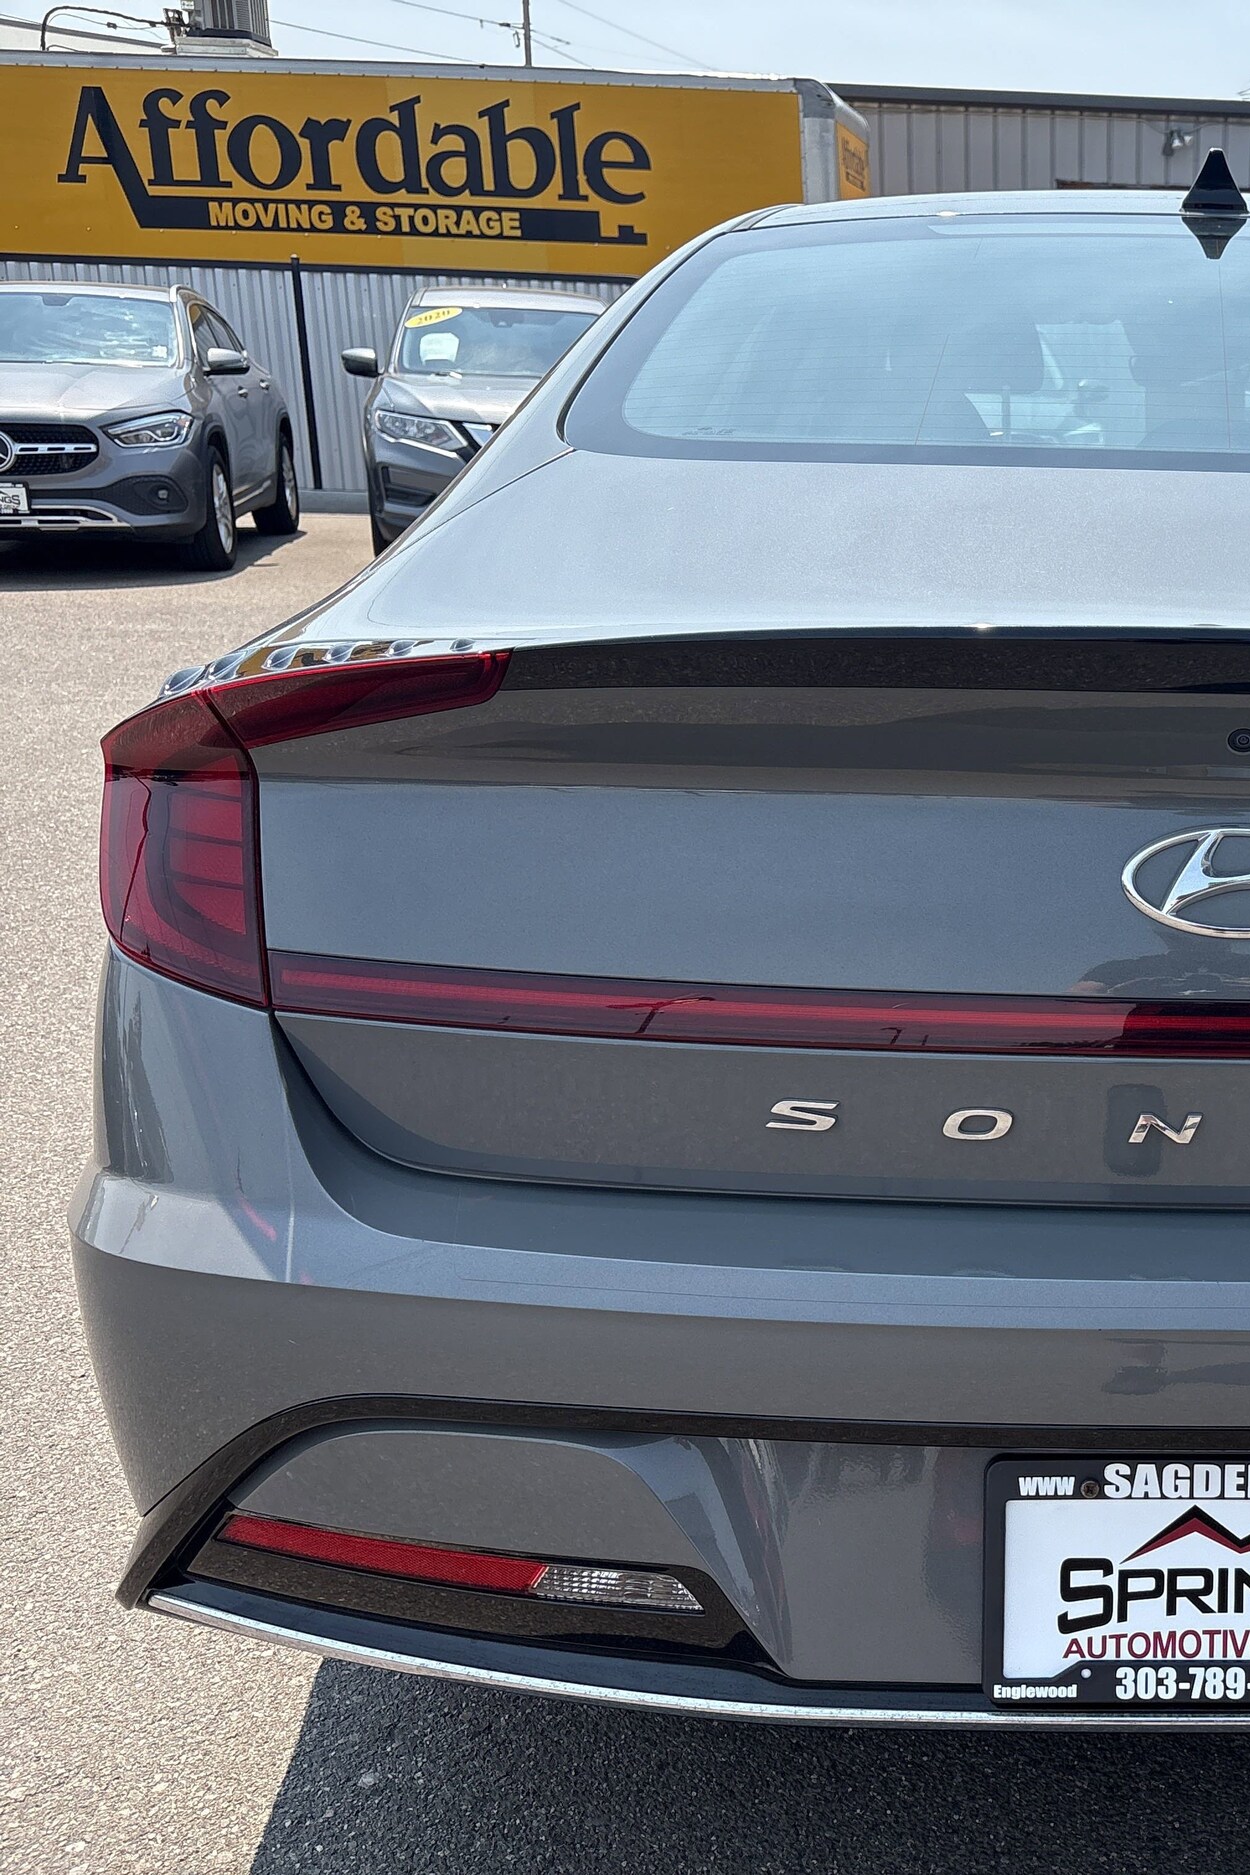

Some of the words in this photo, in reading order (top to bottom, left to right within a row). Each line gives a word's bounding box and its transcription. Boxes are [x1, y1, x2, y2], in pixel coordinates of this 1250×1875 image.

[57, 86, 652, 206] Affordable
[208, 202, 333, 230] MOVING
[344, 206, 366, 231] &
[375, 207, 521, 237] STORAGE
[1018, 1476, 1076, 1496] www
[993, 1684, 1078, 1700] Englewood
